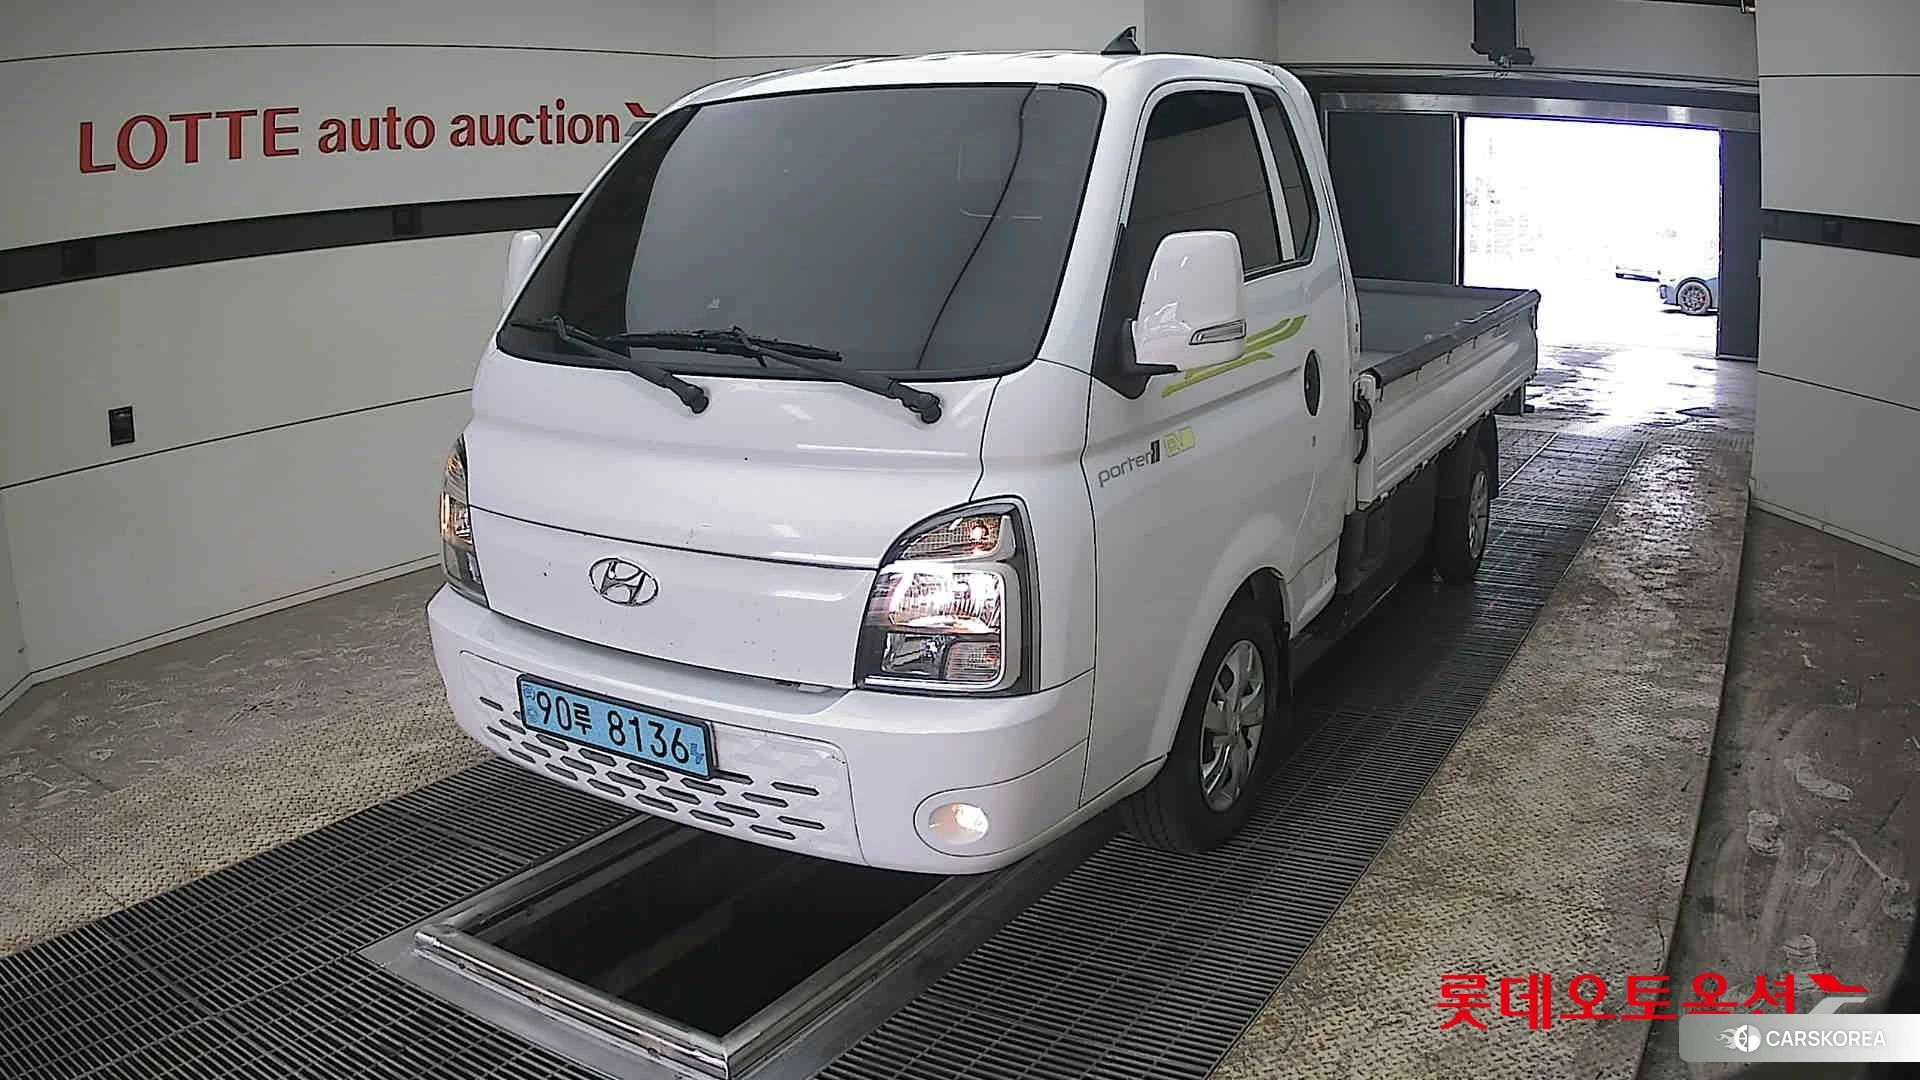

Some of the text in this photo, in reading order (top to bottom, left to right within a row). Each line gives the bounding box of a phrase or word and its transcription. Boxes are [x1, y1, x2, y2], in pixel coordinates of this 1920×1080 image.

[79, 98, 620, 174] LOTTE auto auction
[607, 709, 691, 764] 8136
